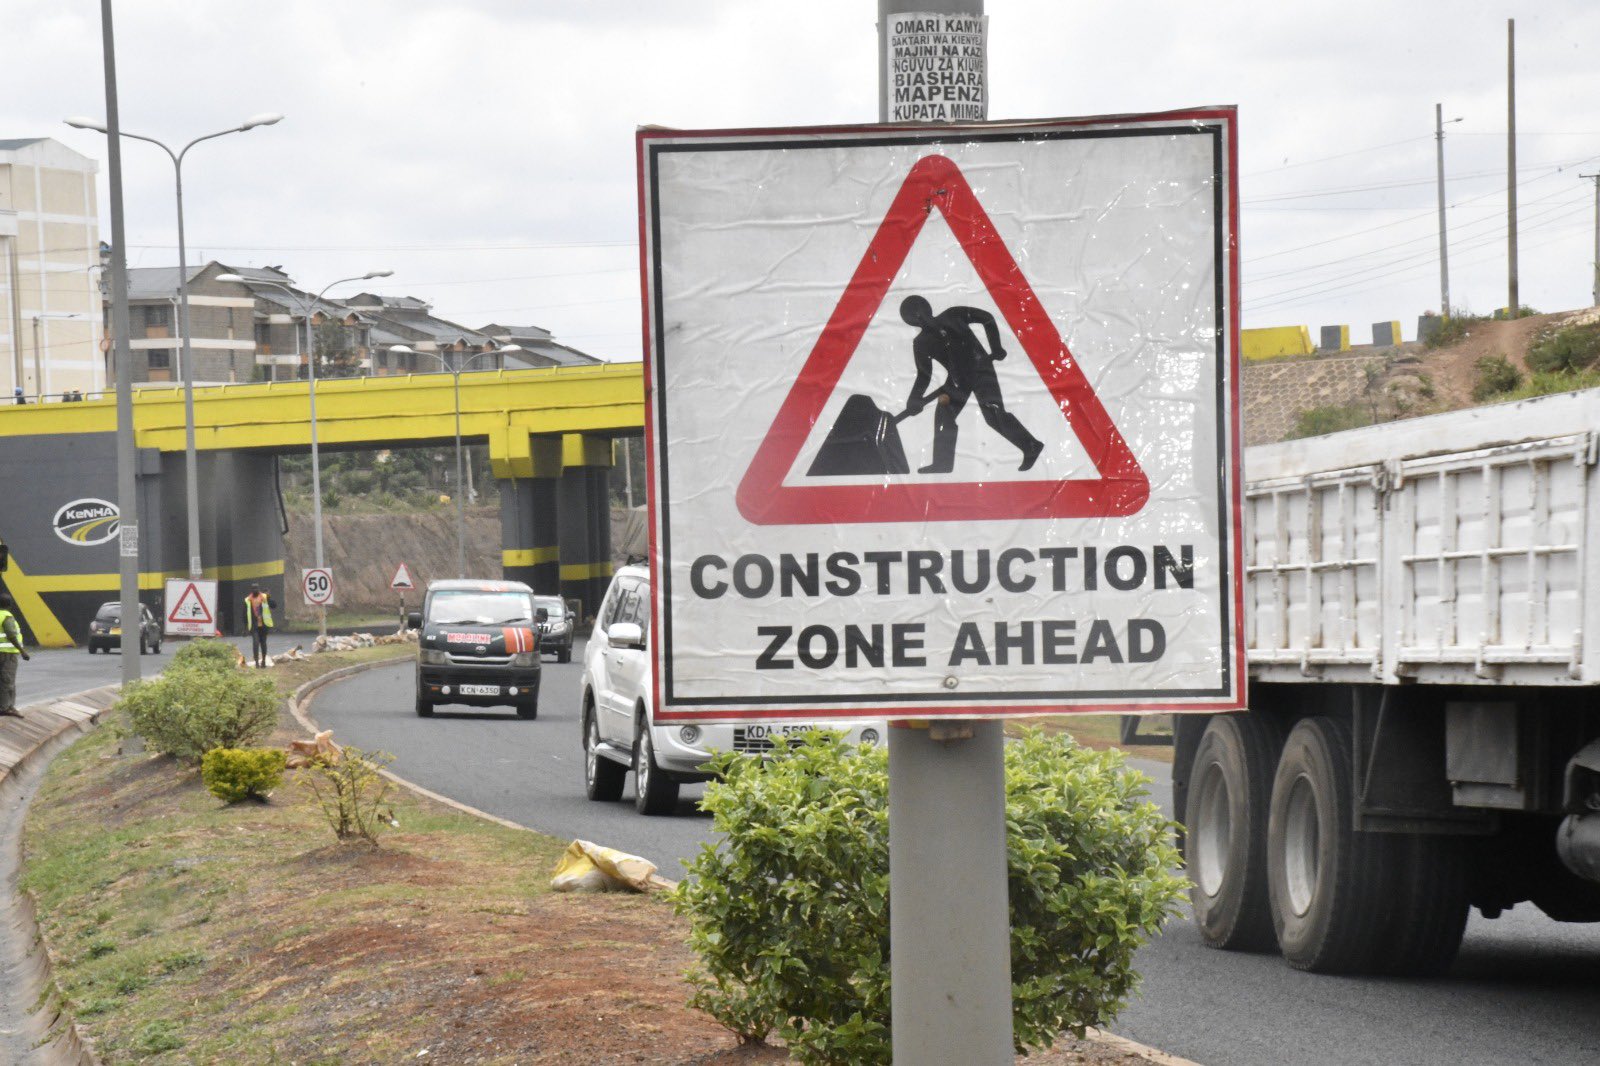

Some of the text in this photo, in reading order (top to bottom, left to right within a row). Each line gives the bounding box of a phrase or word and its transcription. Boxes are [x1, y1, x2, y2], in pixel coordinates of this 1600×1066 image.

[895, 19, 940, 34] OMARI
[892, 35, 930, 47] DAKTARI
[933, 35, 949, 45] WA
[895, 46, 938, 58] MAJINI
[942, 46, 959, 56] NA
[894, 59, 934, 73] NGUVU
[938, 58, 954, 72] ZA
[895, 71, 984, 87] BIASHARA
[895, 86, 984, 103] MAPENZI
[894, 104, 946, 120] KUPATA
[66, 507, 114, 520] KeNHA
[689, 544, 1195, 600] CONSTRUCTION
[308, 576, 328, 592] 50
[755, 619, 1167, 670] ZONE AHEAD
